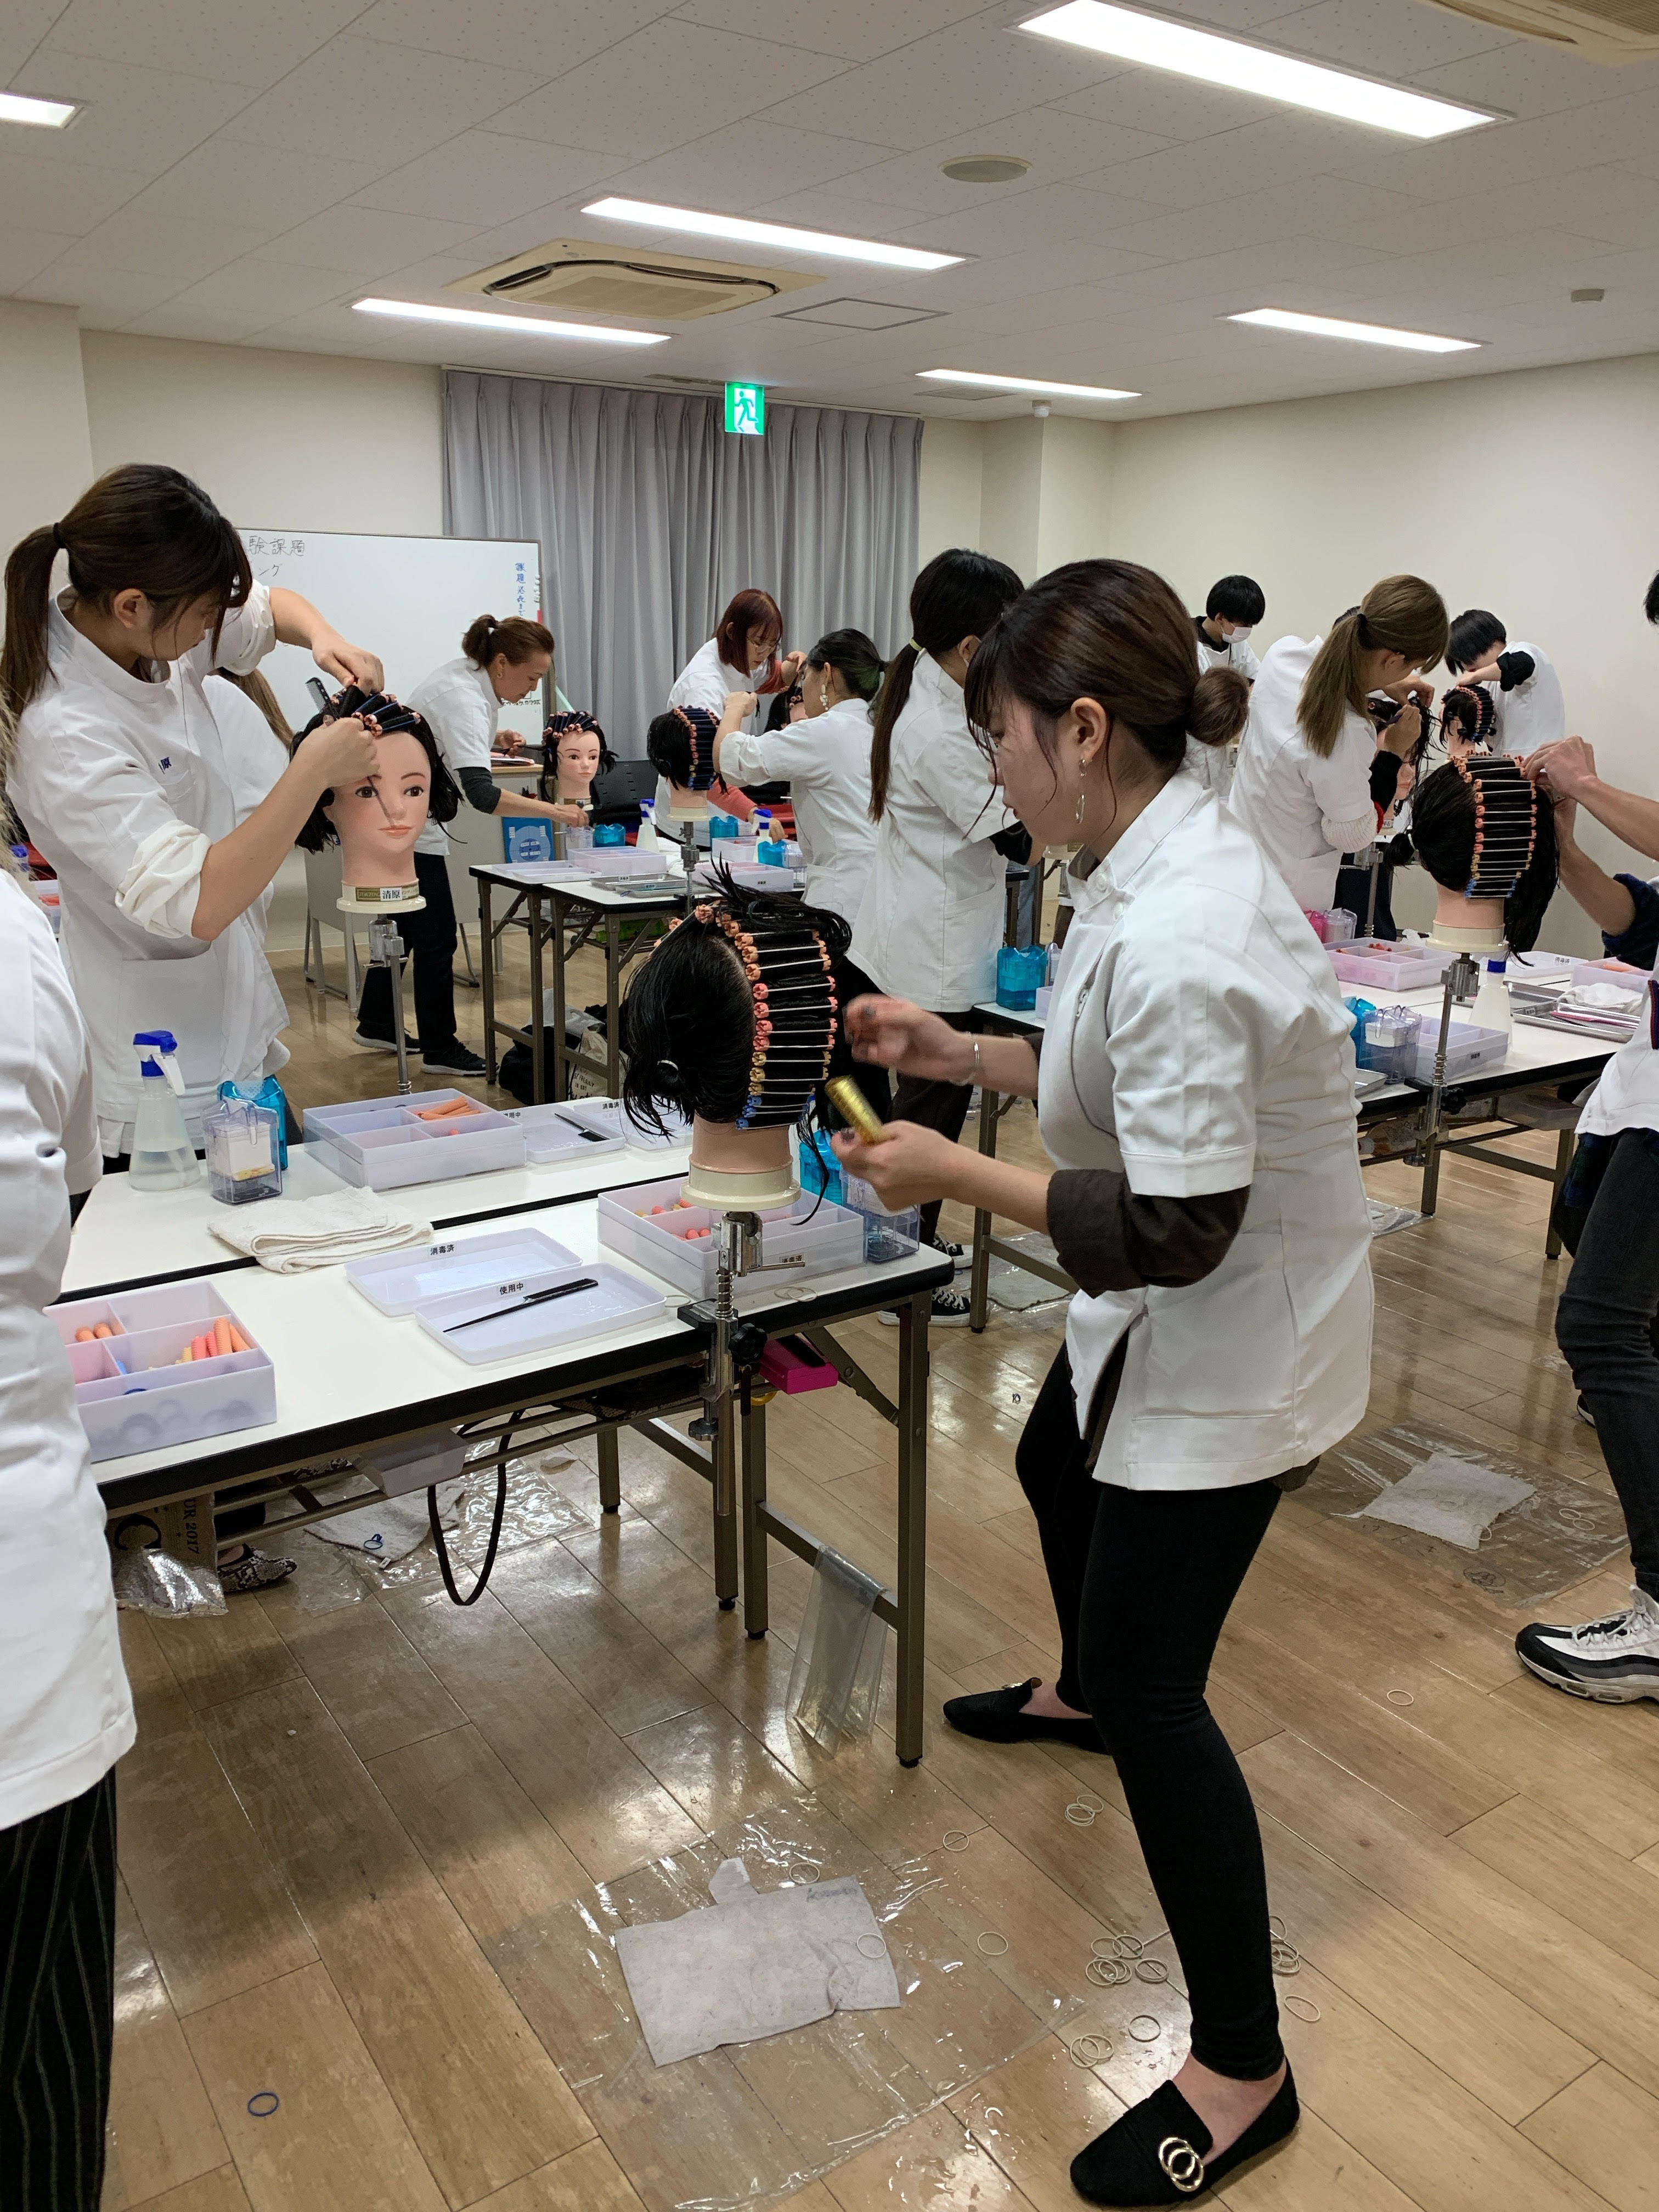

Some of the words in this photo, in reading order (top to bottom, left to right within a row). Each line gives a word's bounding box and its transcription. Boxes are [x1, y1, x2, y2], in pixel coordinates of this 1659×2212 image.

[430, 1244, 455, 1256] 消毒済
[499, 1282, 523, 1295] 使用中
[185, 1522, 200, 1554] 2017
